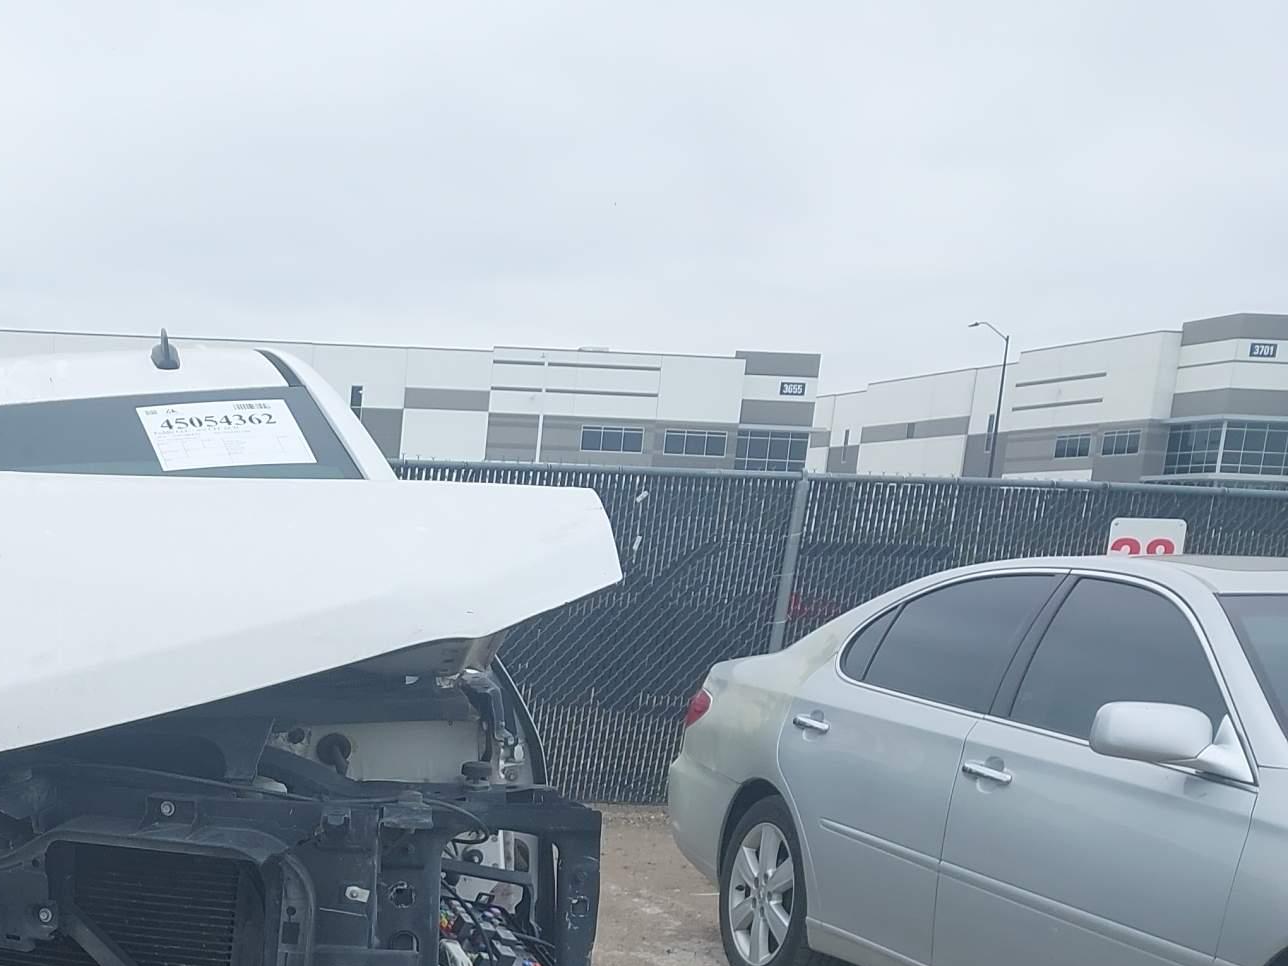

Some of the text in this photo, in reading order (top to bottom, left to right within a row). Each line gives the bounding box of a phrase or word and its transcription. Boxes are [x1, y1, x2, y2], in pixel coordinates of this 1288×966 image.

[1253, 344, 1274, 356] 3701
[782, 383, 803, 394] 3655
[160, 413, 277, 430] 45054362
